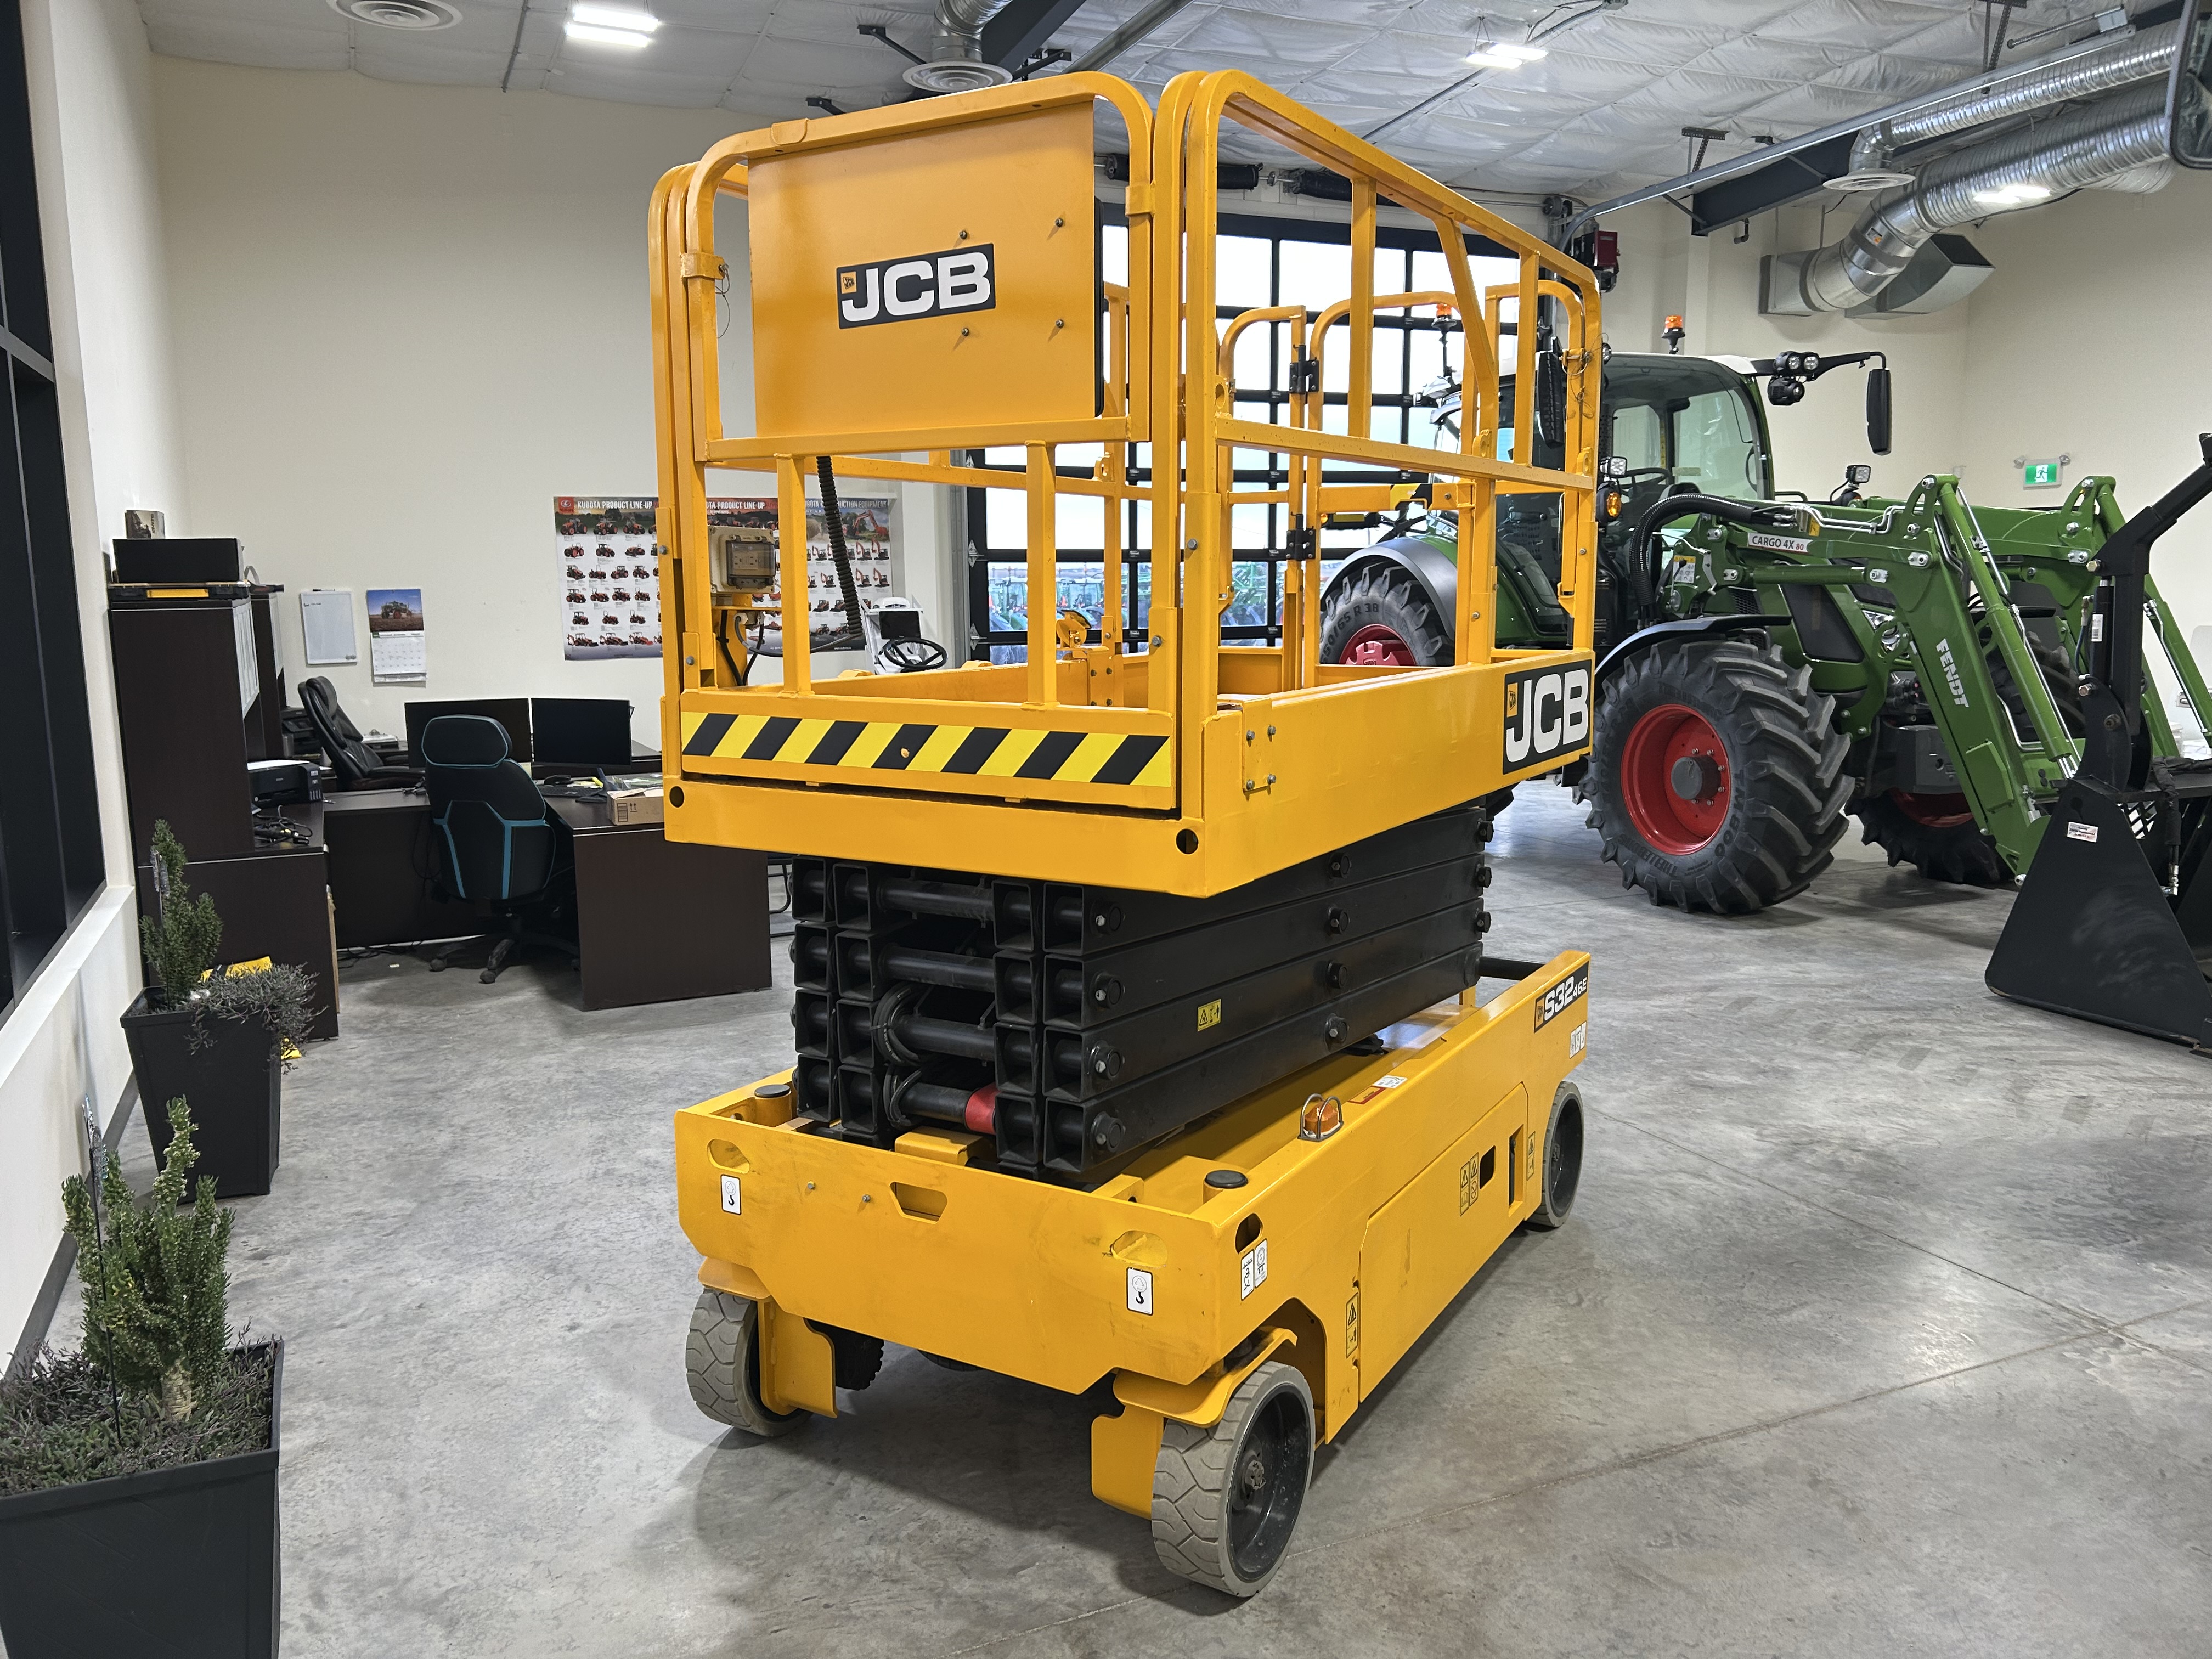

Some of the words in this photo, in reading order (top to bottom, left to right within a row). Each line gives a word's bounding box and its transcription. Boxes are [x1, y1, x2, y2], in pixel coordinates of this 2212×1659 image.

[842, 252, 991, 321] JCB
[577, 501, 601, 509] KUBOTA
[602, 501, 629, 509] PRODUCT
[630, 501, 653, 509] LINE-UP
[859, 500, 887, 509] EQUIPMENT
[1752, 535, 1782, 548] CARGO
[1783, 540, 1795, 549] 4X
[1936, 638, 1970, 708] FENDT
[1506, 669, 1588, 763] JCB
